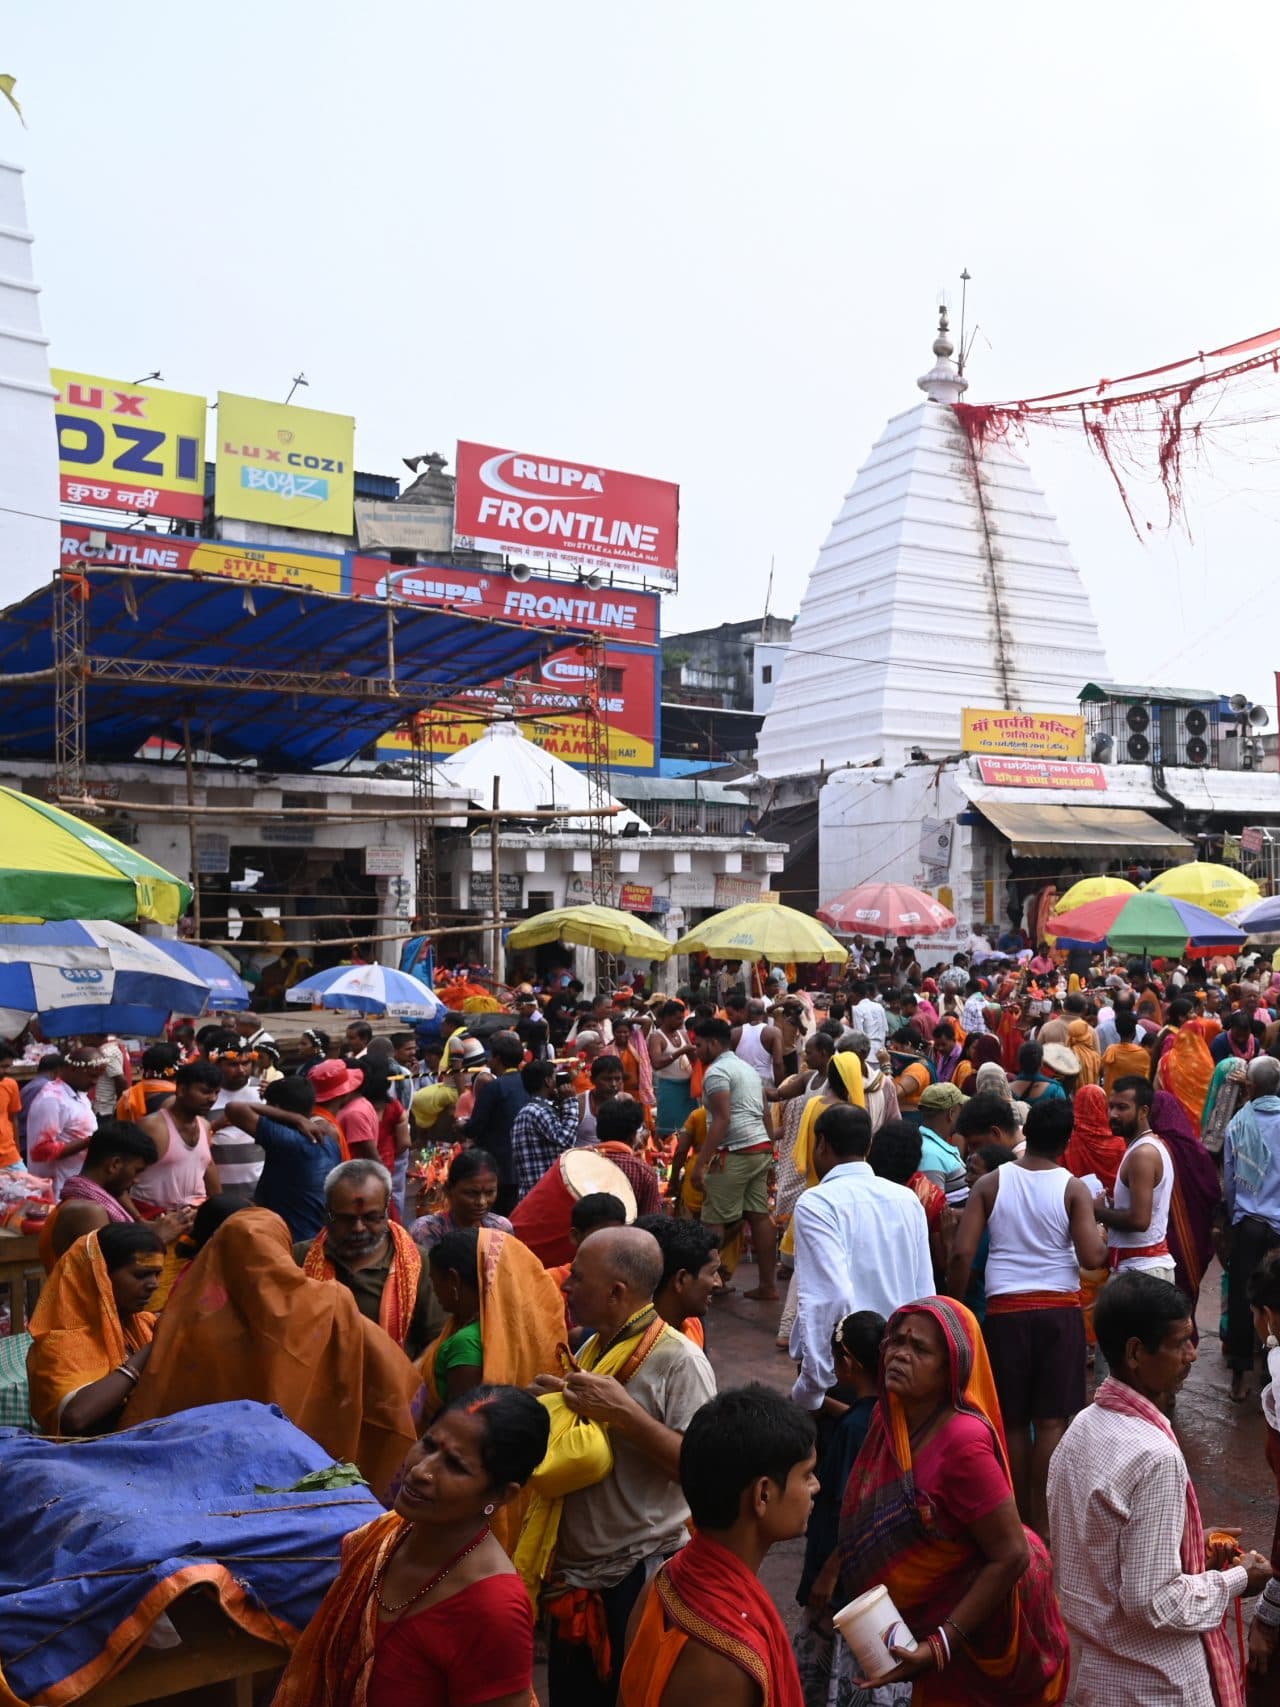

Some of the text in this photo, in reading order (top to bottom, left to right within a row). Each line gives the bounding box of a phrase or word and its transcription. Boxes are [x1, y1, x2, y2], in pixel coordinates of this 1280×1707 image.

[54, 384, 146, 418] UX
[223, 442, 344, 475] LUX COZI
[513, 458, 604, 493] RUPA
[66, 482, 160, 508] कुछ नहीं
[477, 496, 660, 552] FRONTLINE
[60, 537, 179, 569] RONTLINE
[577, 542, 602, 552] STYLE
[613, 549, 643, 559] MAMLA
[224, 558, 299, 576] STYLE KA
[402, 578, 638, 630] RUPA FRONTLINE
[993, 715, 1034, 729] पार्वती
[1039, 720, 1077, 738] मन्दिर
